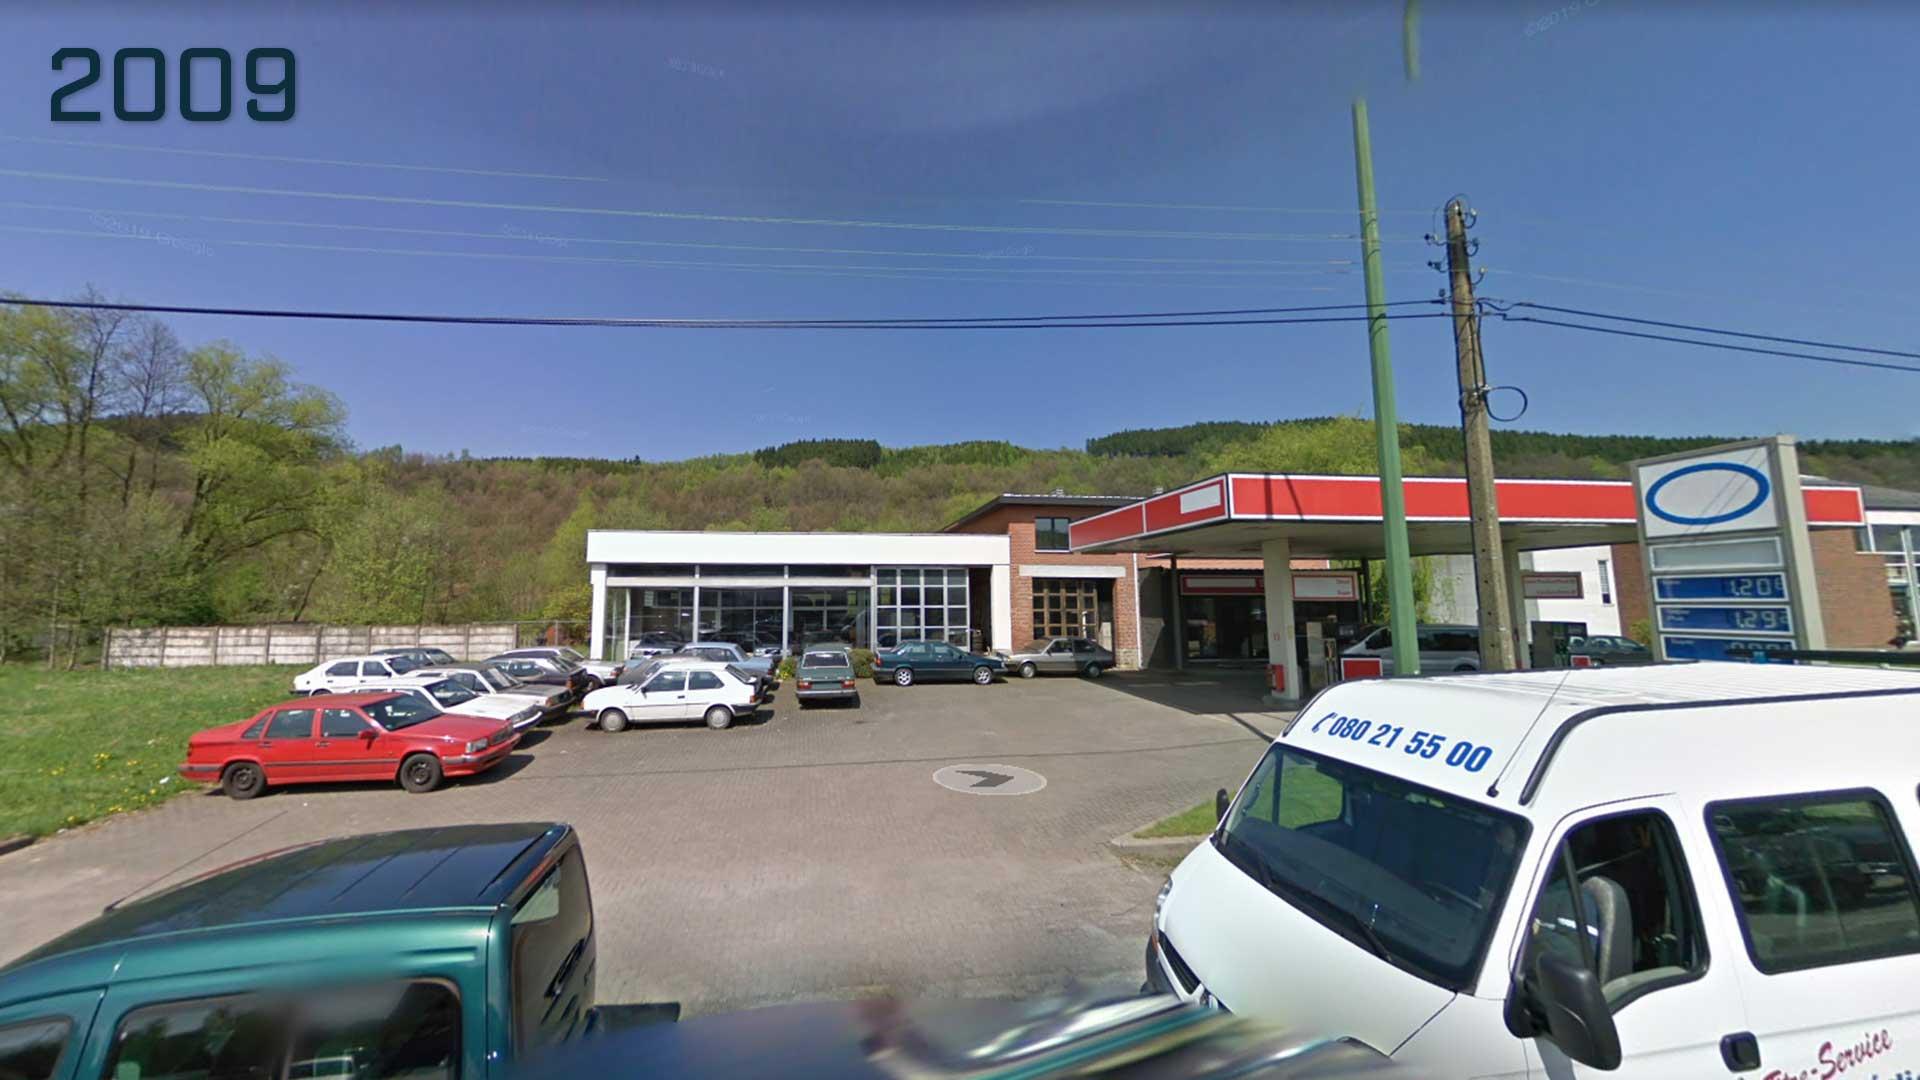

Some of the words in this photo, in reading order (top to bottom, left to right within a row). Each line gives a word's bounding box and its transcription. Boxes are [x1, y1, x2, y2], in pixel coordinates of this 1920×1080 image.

[1328, 716, 1372, 741] 080
[1368, 723, 1404, 748] 21
[1404, 731, 1446, 759] 55
[1445, 741, 1493, 772] 00
